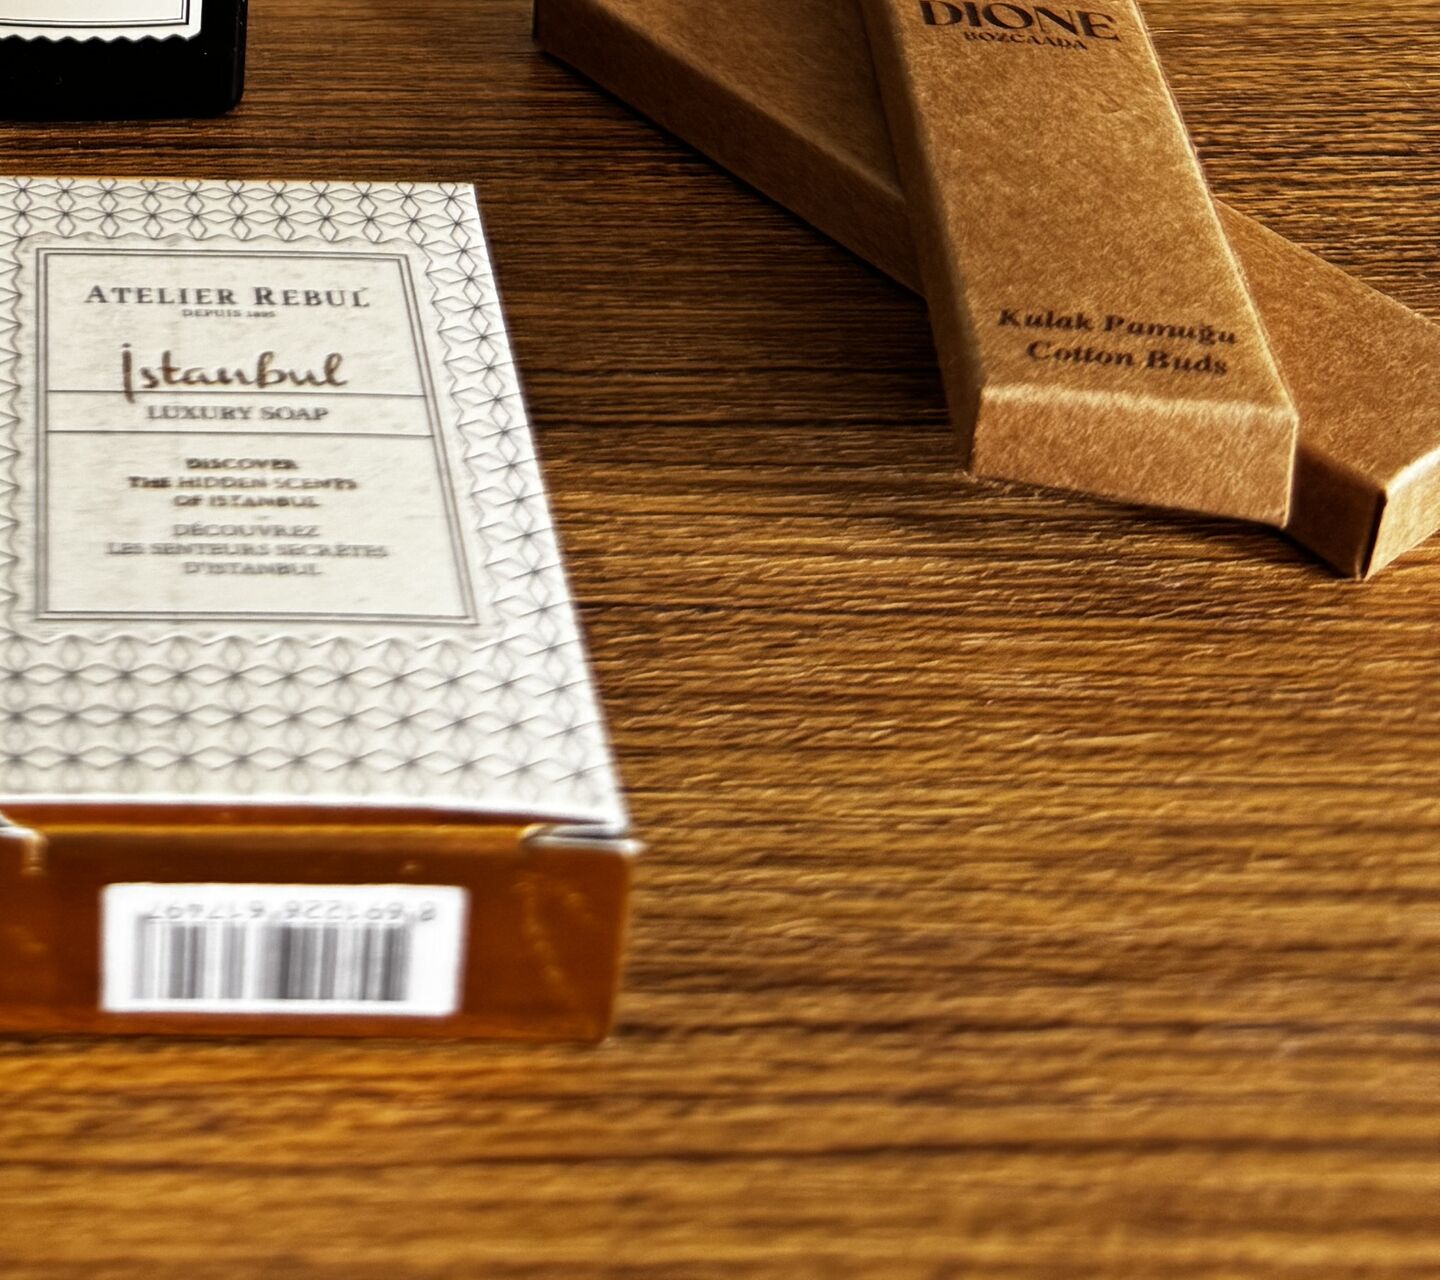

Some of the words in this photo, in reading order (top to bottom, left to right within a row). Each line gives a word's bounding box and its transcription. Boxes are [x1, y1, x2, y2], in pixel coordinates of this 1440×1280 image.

[83, 285, 238, 305] ATELIER
[253, 286, 371, 308] REBUL
[996, 307, 1095, 332] Kulak
[1101, 313, 1237, 346] Pamuğu
[1025, 340, 1135, 367] Cotton
[1145, 348, 1229, 376] Buds
[147, 404, 254, 420] LUXURY
[260, 406, 330, 421] SOAP
[185, 457, 299, 470] DISCOVER
[178, 476, 268, 489] HIDDEN
